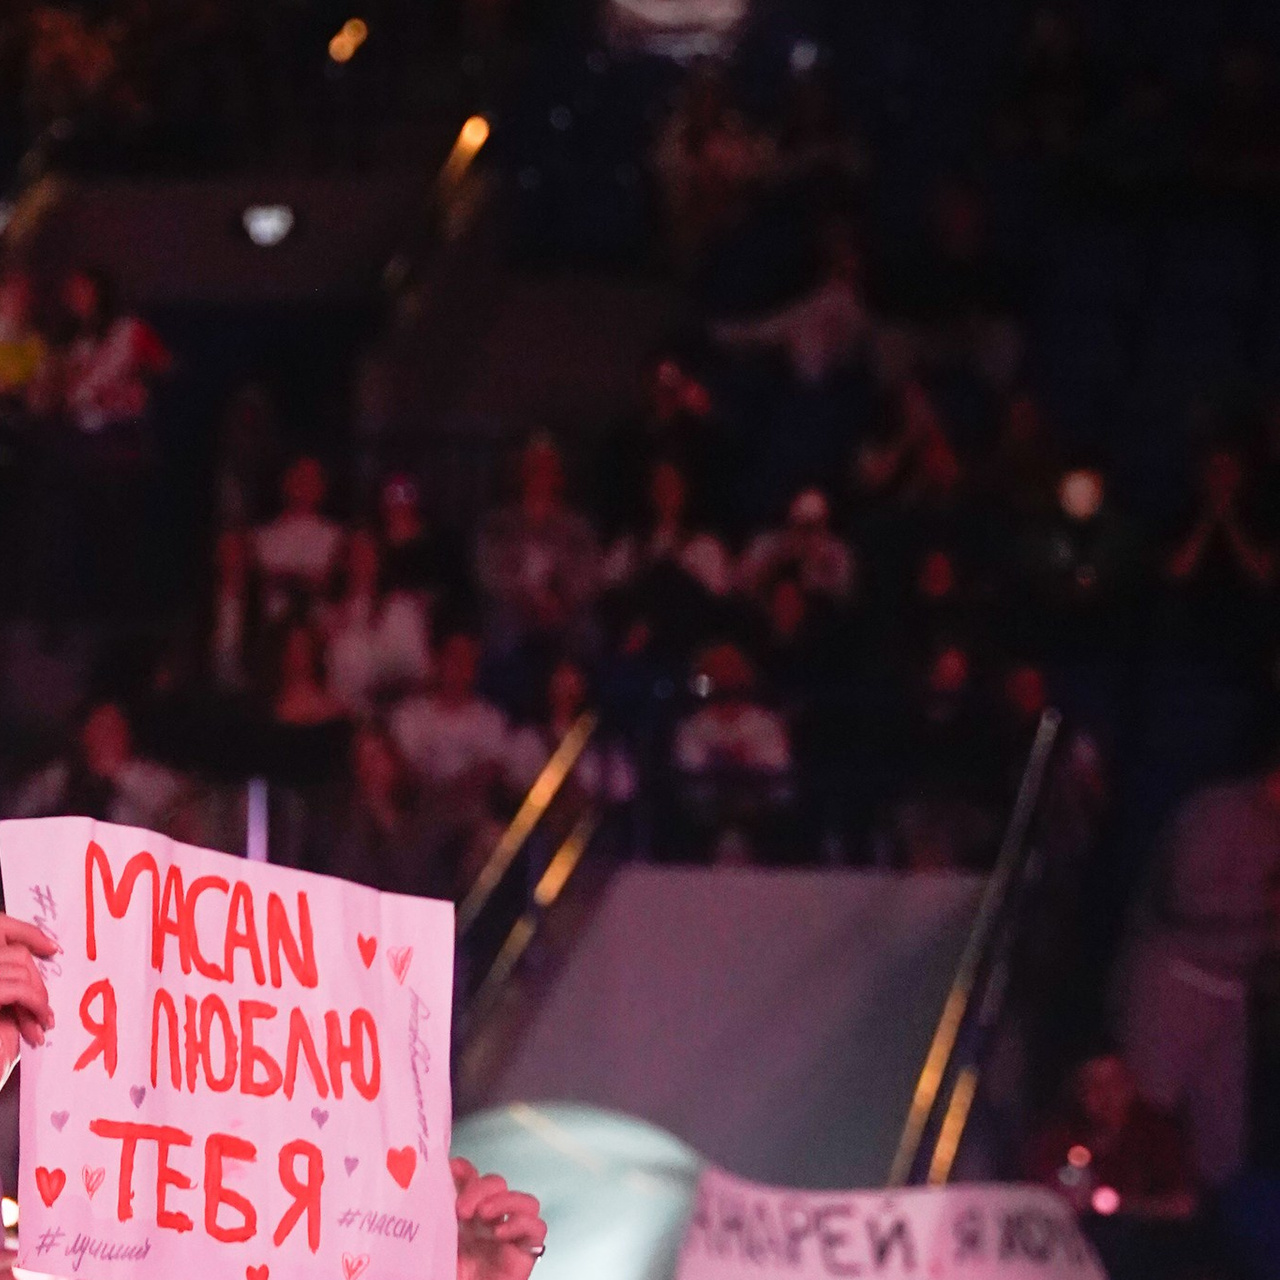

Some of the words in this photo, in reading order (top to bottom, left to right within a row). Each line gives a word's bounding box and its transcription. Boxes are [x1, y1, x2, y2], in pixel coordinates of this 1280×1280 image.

[85, 840, 319, 989] MACAN
[73, 977, 118, 1079] Я
[150, 987, 381, 1101] ЛЮБЛЮ
[89, 1118, 324, 1254] ТЕБЯ
